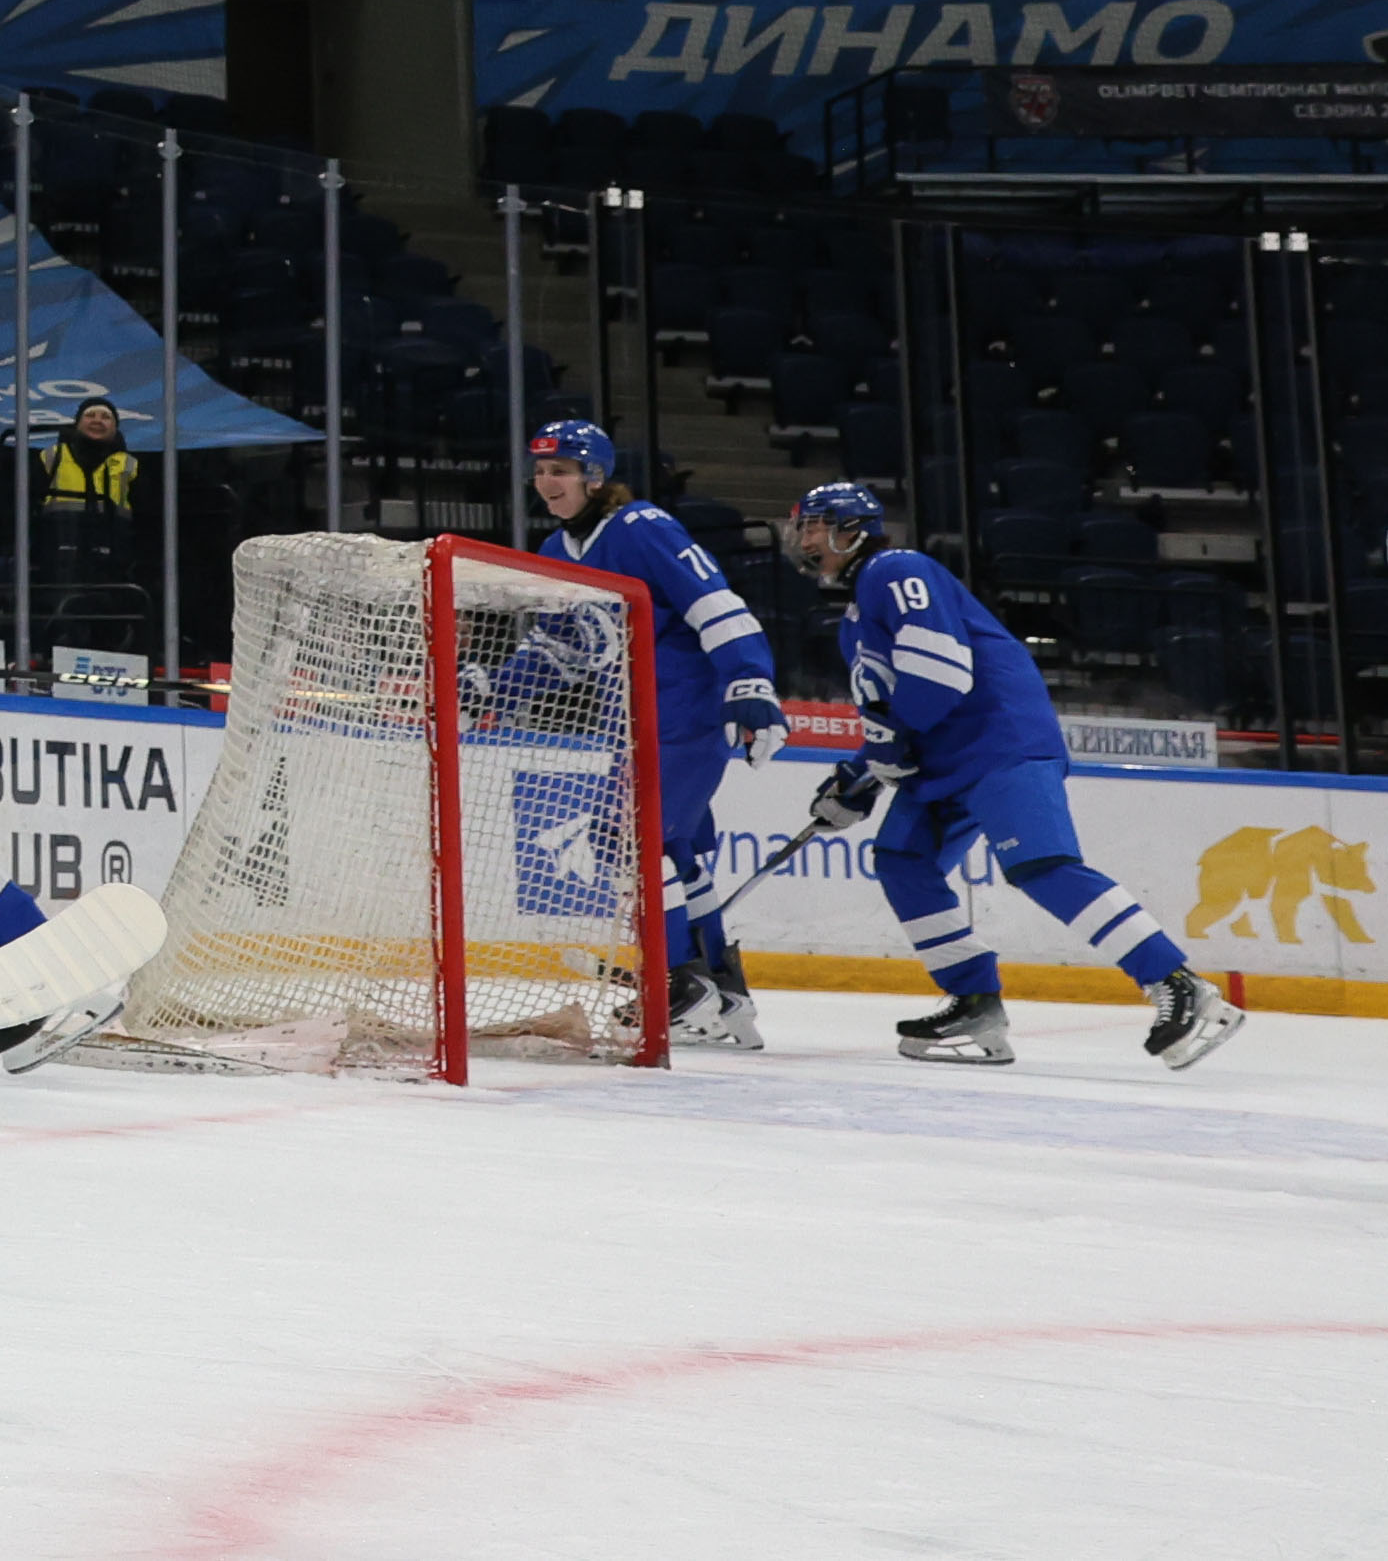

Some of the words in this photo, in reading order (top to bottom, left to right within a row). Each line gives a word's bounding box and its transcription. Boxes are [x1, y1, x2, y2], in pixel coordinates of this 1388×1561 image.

[608, 0, 1236, 84] ДИНАМО
[887, 576, 932, 614] 19
[59, 673, 151, 689] CCM
[786, 714, 860, 737] PBET
